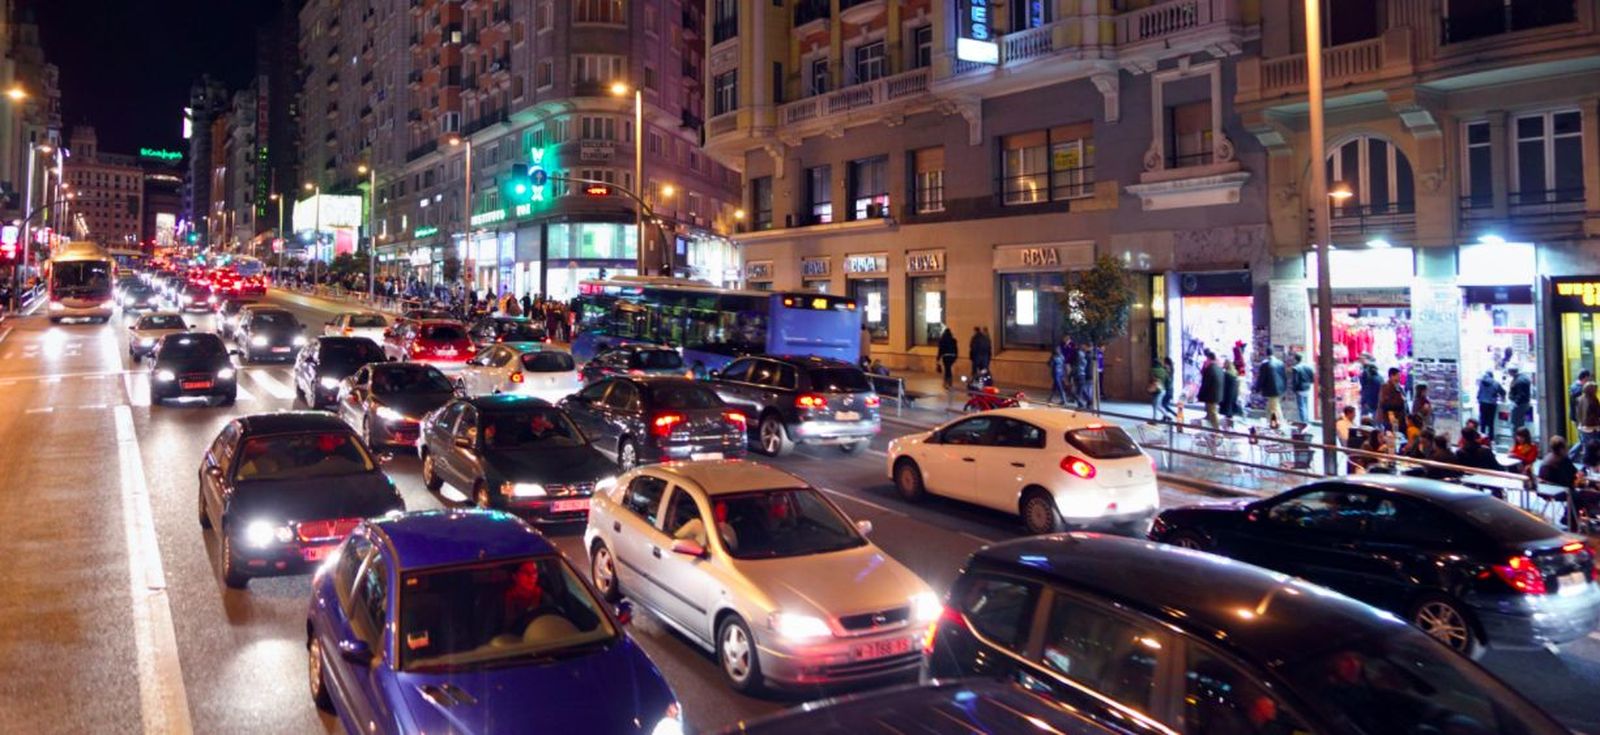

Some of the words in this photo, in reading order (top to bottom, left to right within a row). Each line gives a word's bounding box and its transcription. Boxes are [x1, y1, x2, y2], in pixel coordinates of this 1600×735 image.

[528, 147, 545, 201] VX
[849, 255, 878, 272] BBVA
[907, 254, 940, 272] BBVA
[1021, 247, 1060, 266] BBVA
